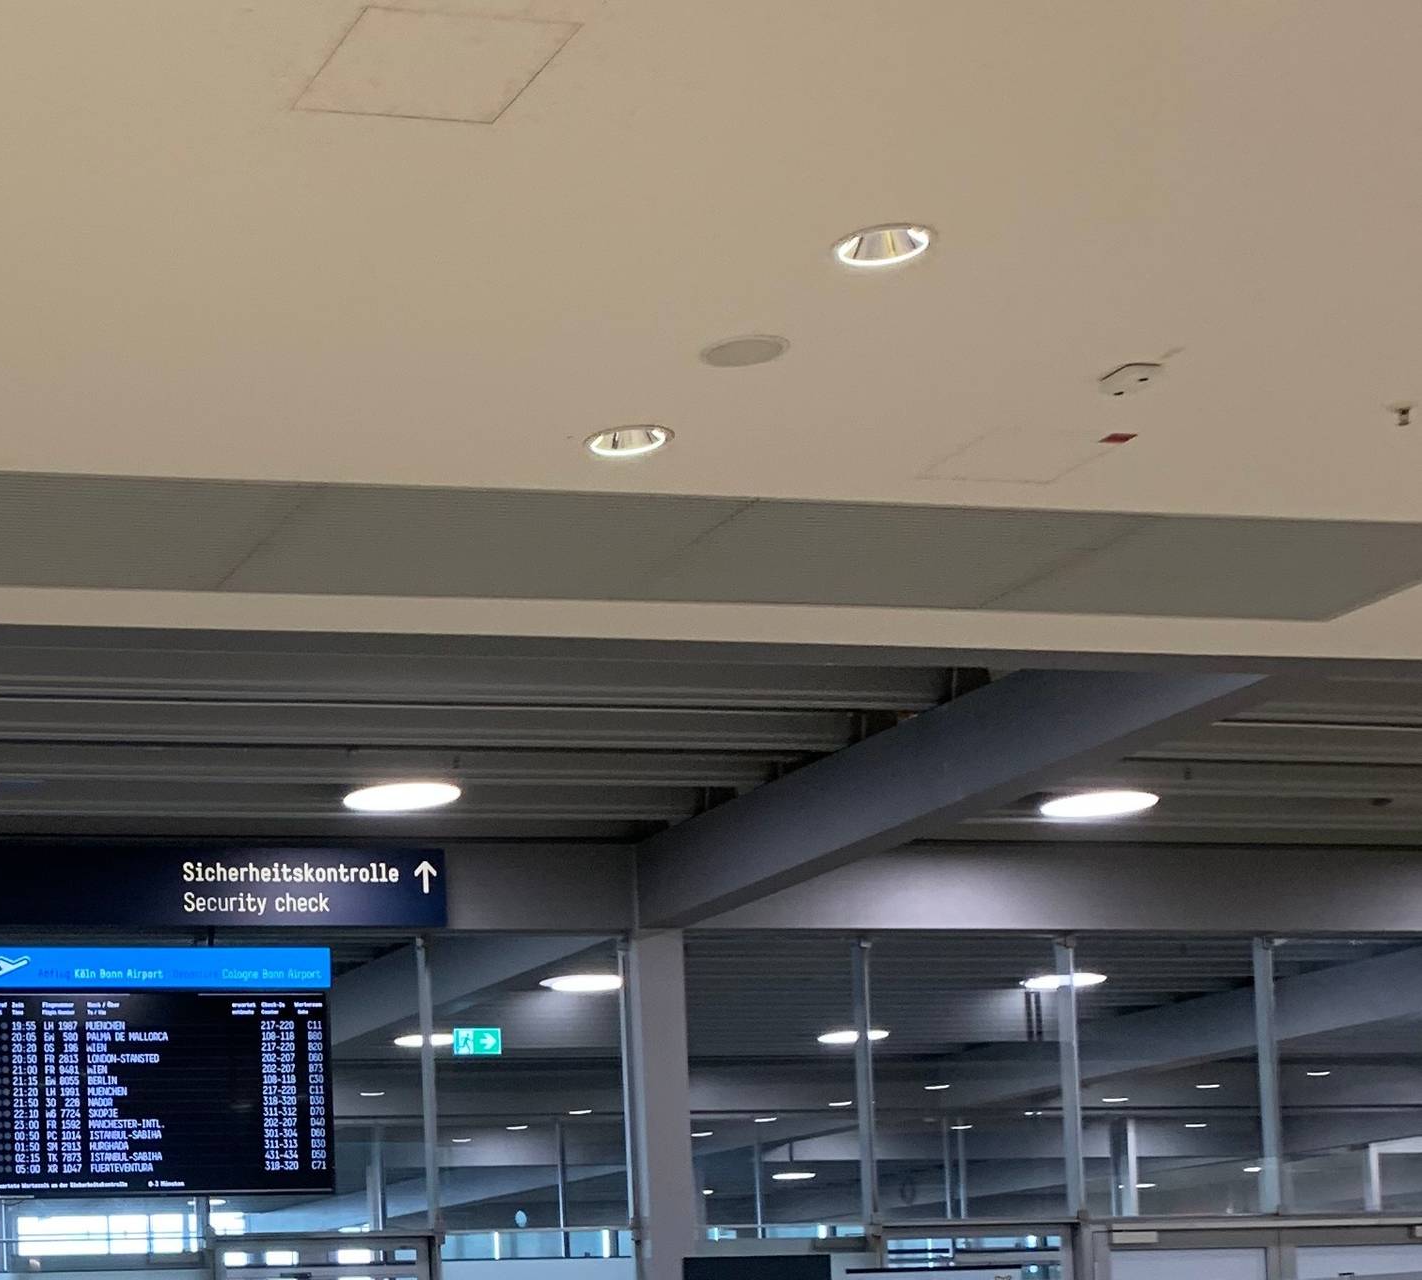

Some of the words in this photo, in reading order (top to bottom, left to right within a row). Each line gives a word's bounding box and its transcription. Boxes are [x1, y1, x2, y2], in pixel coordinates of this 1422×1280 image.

[182, 862, 400, 883] Sicherheitskontrolle
[183, 892, 267, 916] Security
[274, 893, 330, 913] check
[74, 968, 96, 978] Köln
[99, 969, 123, 979] Bonn
[127, 969, 164, 980] Airport
[222, 969, 259, 980] Cologne
[262, 969, 284, 979] Bonn
[288, 969, 322, 980] Airport
[12, 1021, 37, 1031] 19:55
[86, 1021, 126, 1031] MUENCHEN
[261, 1021, 295, 1031] 217-220
[12, 1032, 37, 1042] 20:05
[87, 1032, 112, 1042] PALMA
[115, 1032, 126, 1042] DE
[129, 1032, 169, 1042] MALLORCA
[262, 1032, 295, 1042] 108-118
[12, 1043, 38, 1053] 20:20
[86, 1043, 108, 1053] WIEN
[261, 1042, 296, 1052] 217-220
[12, 1054, 38, 1064] 20:50
[87, 1054, 160, 1064] LONDON-STANSTED
[262, 1053, 296, 1063] 202-207
[87, 1065, 108, 1075] WIEN
[262, 1064, 296, 1074] 202-207
[13, 1077, 39, 1087] 21:15
[88, 1076, 118, 1086] BERLIN
[263, 1075, 297, 1085] 108-118
[13, 1088, 39, 1098] 21:20
[88, 1087, 128, 1097] MUENCHEN
[263, 1086, 297, 1096] 217-220
[14, 1098, 39, 1108] 21:50
[88, 1098, 114, 1108] NADOR
[263, 1096, 297, 1106] 318-320
[14, 1109, 40, 1119] 22:10
[61, 1109, 81, 1119] 7724
[89, 1108, 119, 1118] SKOPJE
[263, 1107, 298, 1117] 311-312
[14, 1120, 40, 1130] 23:00
[47, 1120, 56, 1129] FR
[89, 1119, 165, 1129] MANCHESTER-INTL.
[264, 1118, 298, 1128] 202-207
[47, 1131, 57, 1140] PC
[62, 1131, 82, 1141] 1014
[90, 1130, 163, 1140] ISTANBUL-SABIHA
[264, 1129, 298, 1139] 301-304
[15, 1142, 41, 1152] 01:50
[90, 1141, 130, 1151] HURGHADA
[265, 1139, 299, 1149] 311-313
[15, 1153, 41, 1163] 02:15
[48, 1153, 58, 1162] TK
[91, 1152, 163, 1162] ISTANBUL-SABIHA
[265, 1150, 299, 1160] 431-434
[16, 1165, 41, 1175] 05:00
[48, 1164, 58, 1173] XR
[63, 1164, 83, 1174] 1047
[91, 1163, 154, 1173] FUERTEVENTURA
[265, 1161, 299, 1171] 318-320
[312, 1160, 327, 1170] C71
